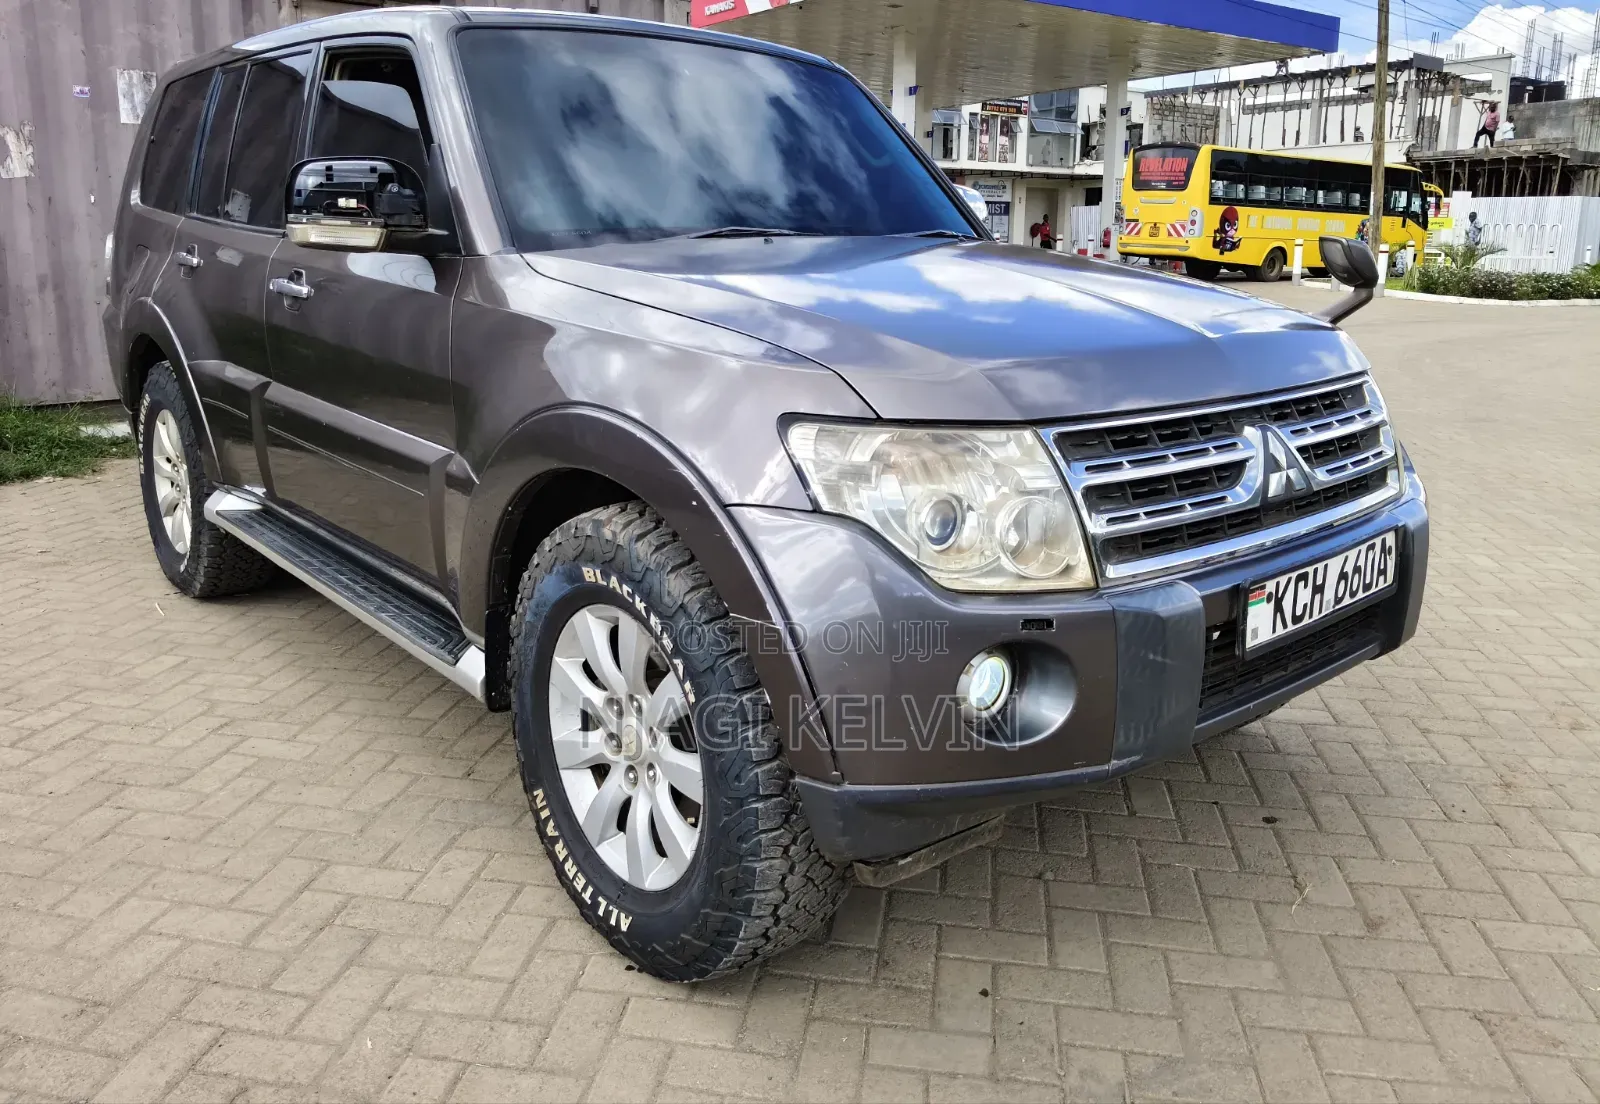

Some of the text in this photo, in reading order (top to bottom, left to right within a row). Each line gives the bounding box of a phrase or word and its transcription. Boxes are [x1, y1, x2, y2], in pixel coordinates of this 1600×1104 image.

[1139, 157, 1188, 172] REVELATION
[1271, 537, 1388, 634] KCH 660A
[533, 788, 633, 932] ALL TERRAIN
